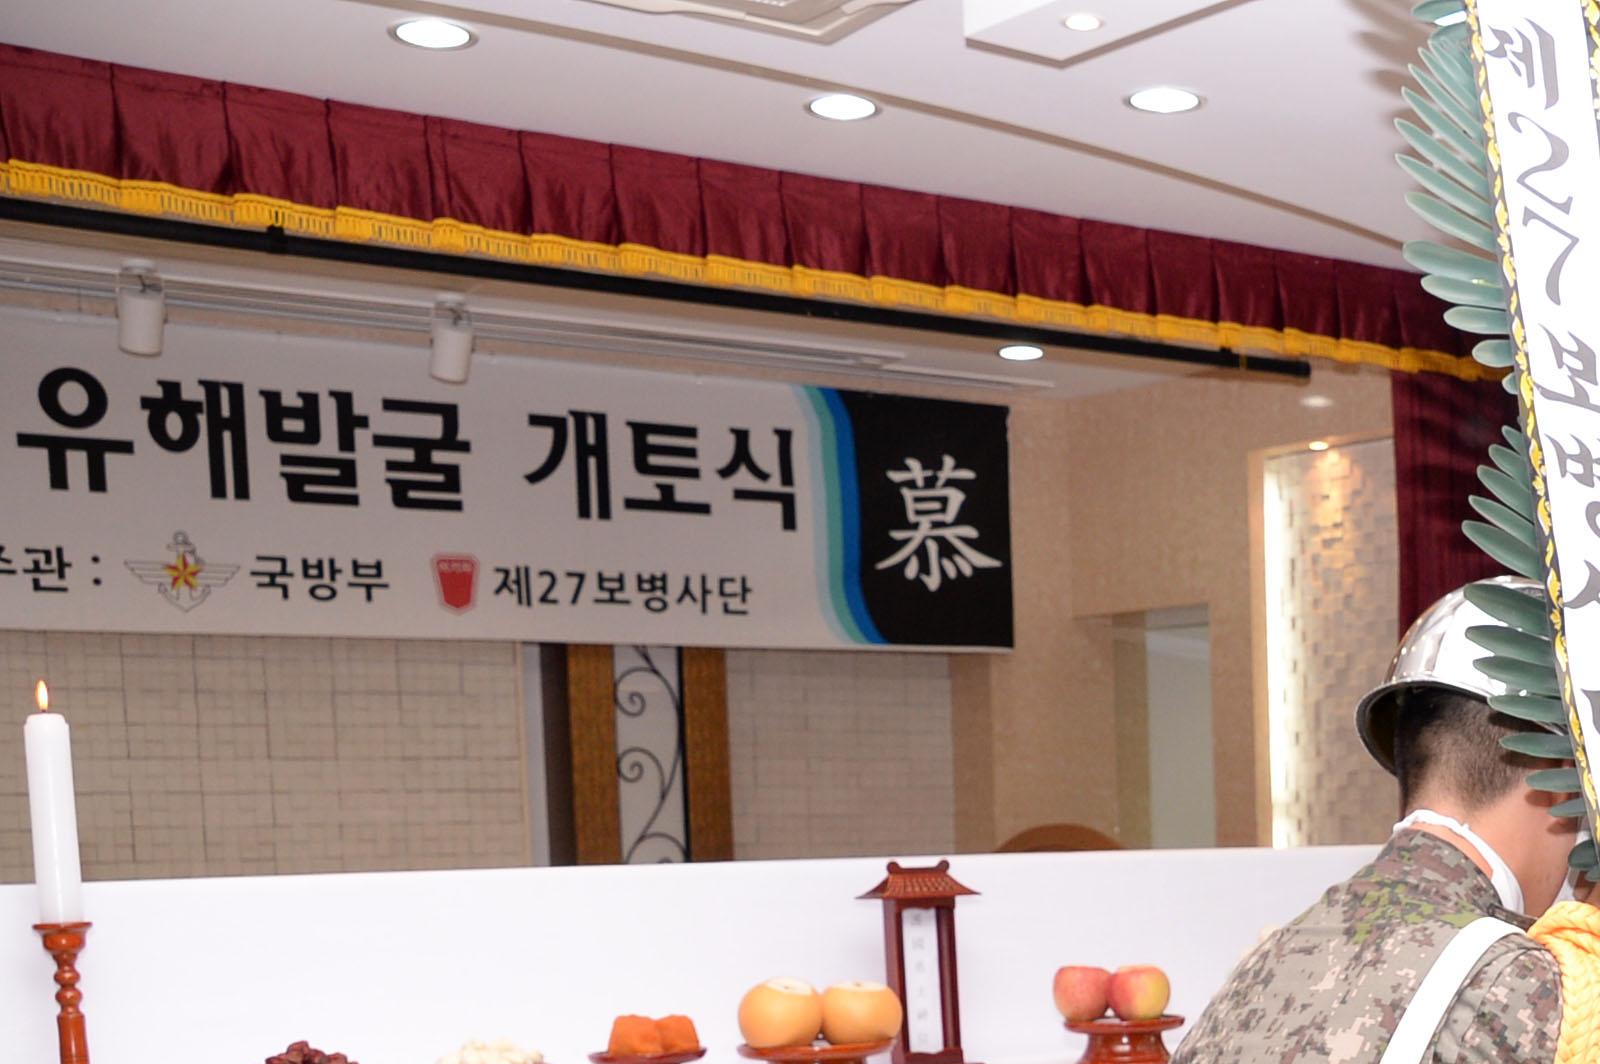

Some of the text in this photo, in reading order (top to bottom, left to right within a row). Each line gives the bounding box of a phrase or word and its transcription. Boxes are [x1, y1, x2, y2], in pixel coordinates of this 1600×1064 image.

[16, 367, 798, 532] 유해발굴 개토식
[250, 556, 390, 603] 국방부
[493, 565, 753, 616] 제27보병사단
[876, 454, 1003, 591] 慕
